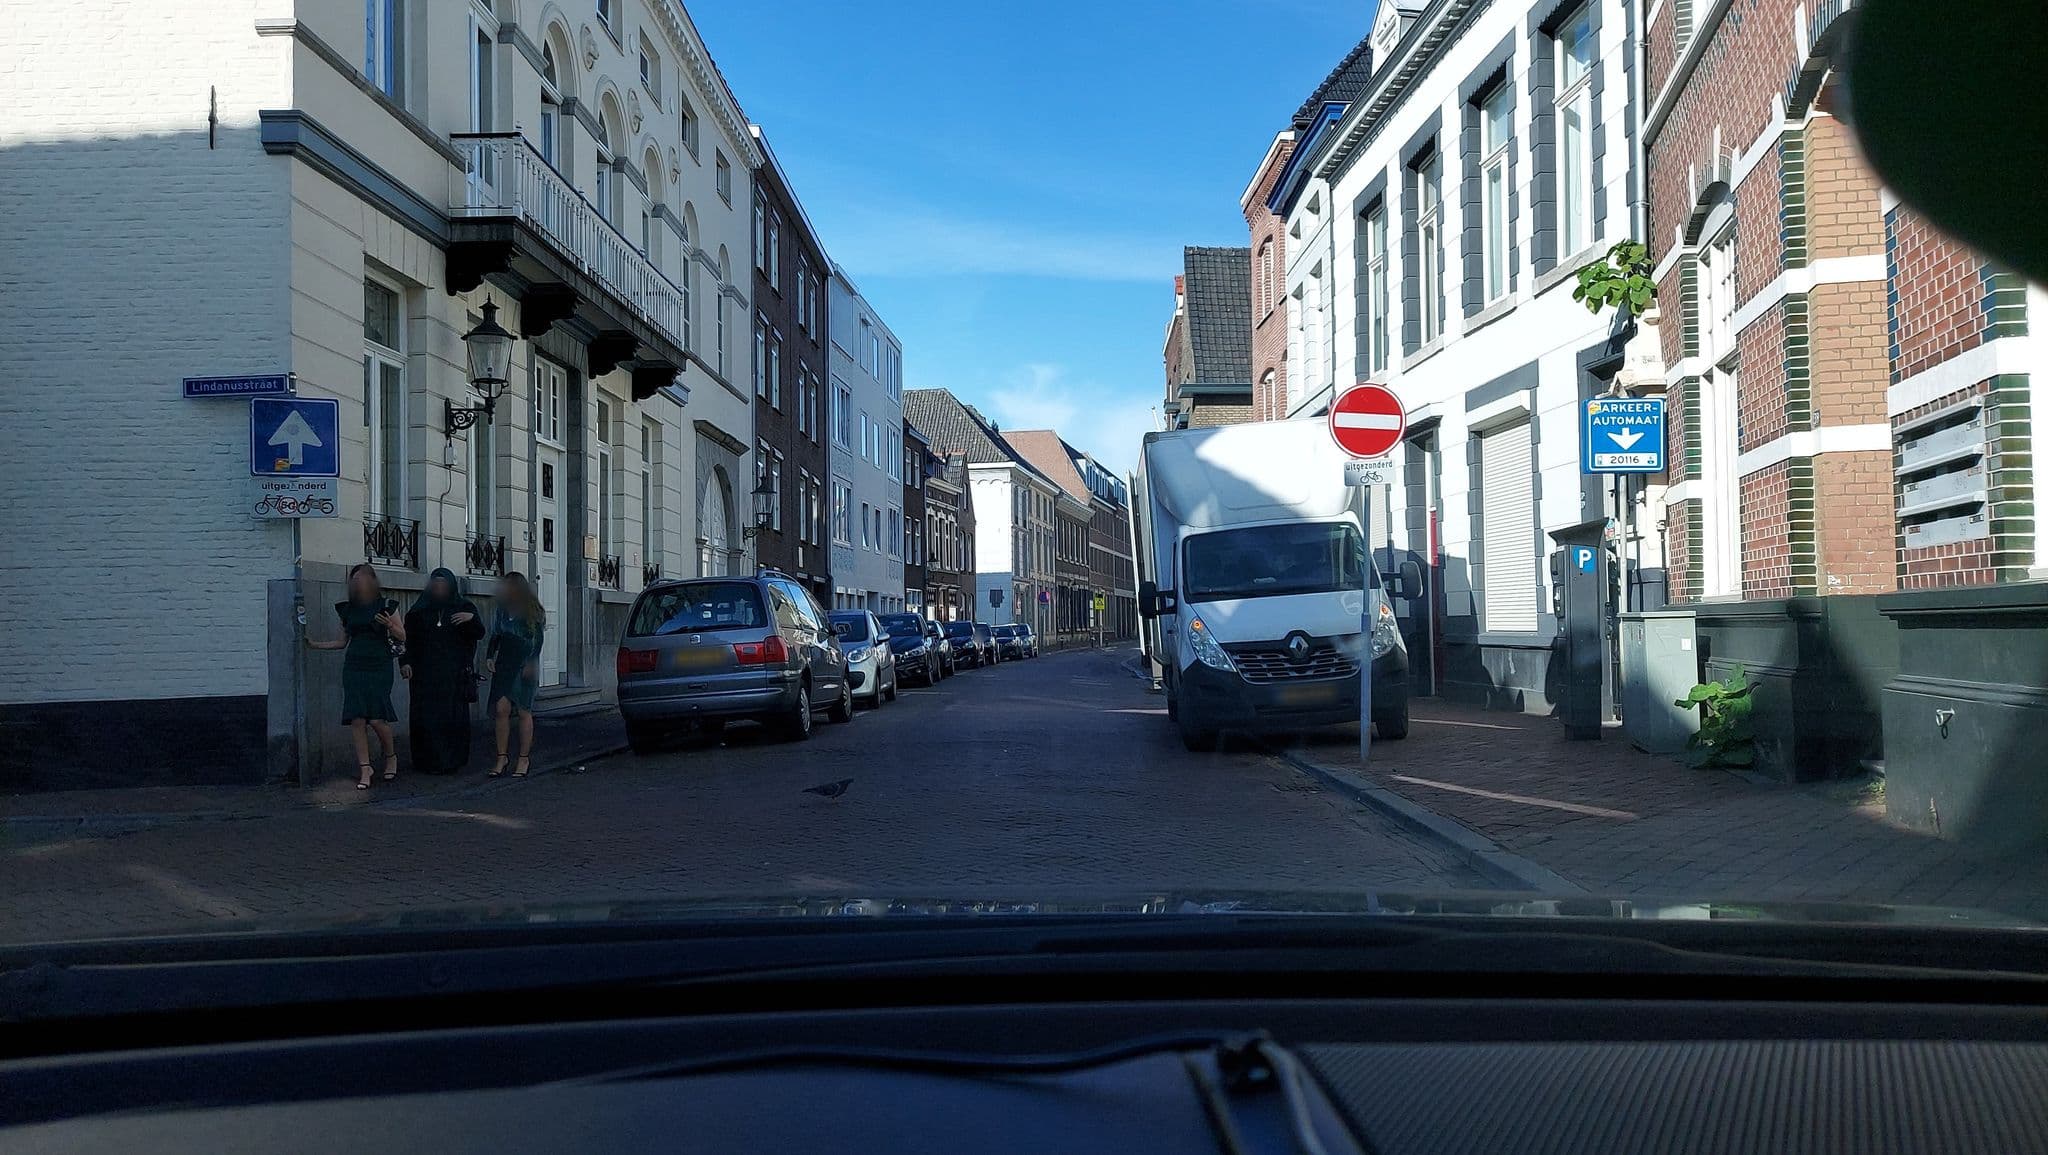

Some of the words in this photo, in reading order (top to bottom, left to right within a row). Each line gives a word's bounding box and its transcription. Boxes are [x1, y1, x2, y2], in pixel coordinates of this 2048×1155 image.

[192, 380, 278, 392] Lindanusstraat
[1594, 403, 1658, 413] ARKEER-
[1593, 416, 1659, 426] AUTOMAAT
[1610, 455, 1640, 464] 20116
[1346, 460, 1393, 472] uitgezonderd
[1579, 549, 1592, 569] P
